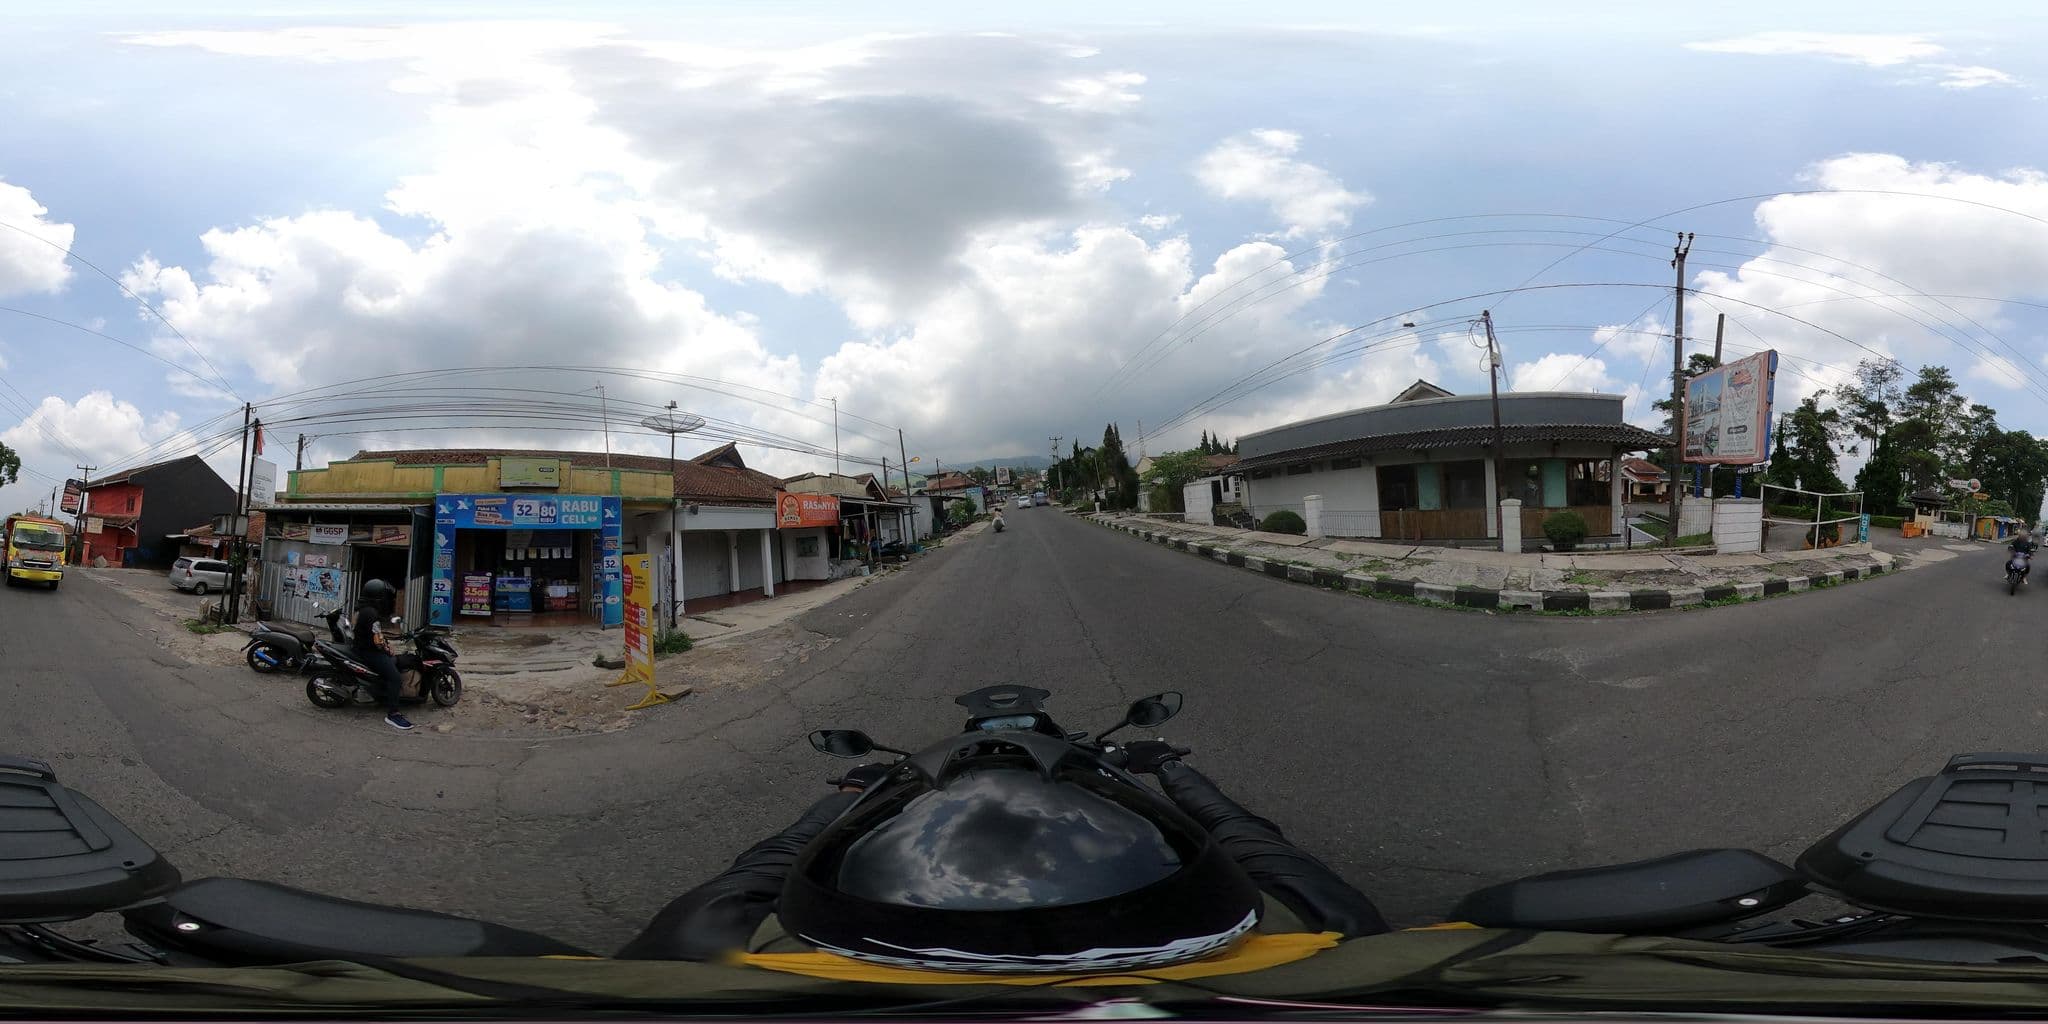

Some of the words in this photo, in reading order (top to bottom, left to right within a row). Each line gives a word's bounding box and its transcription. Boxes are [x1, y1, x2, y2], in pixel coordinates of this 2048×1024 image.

[516, 504, 533, 516] 32
[561, 500, 598, 513] RABU
[540, 506, 556, 517] 80
[561, 514, 588, 524] CELL
[323, 527, 344, 536] GGSP
[604, 560, 616, 569] 32
[434, 583, 446, 592] 32
[433, 597, 444, 605] 80
